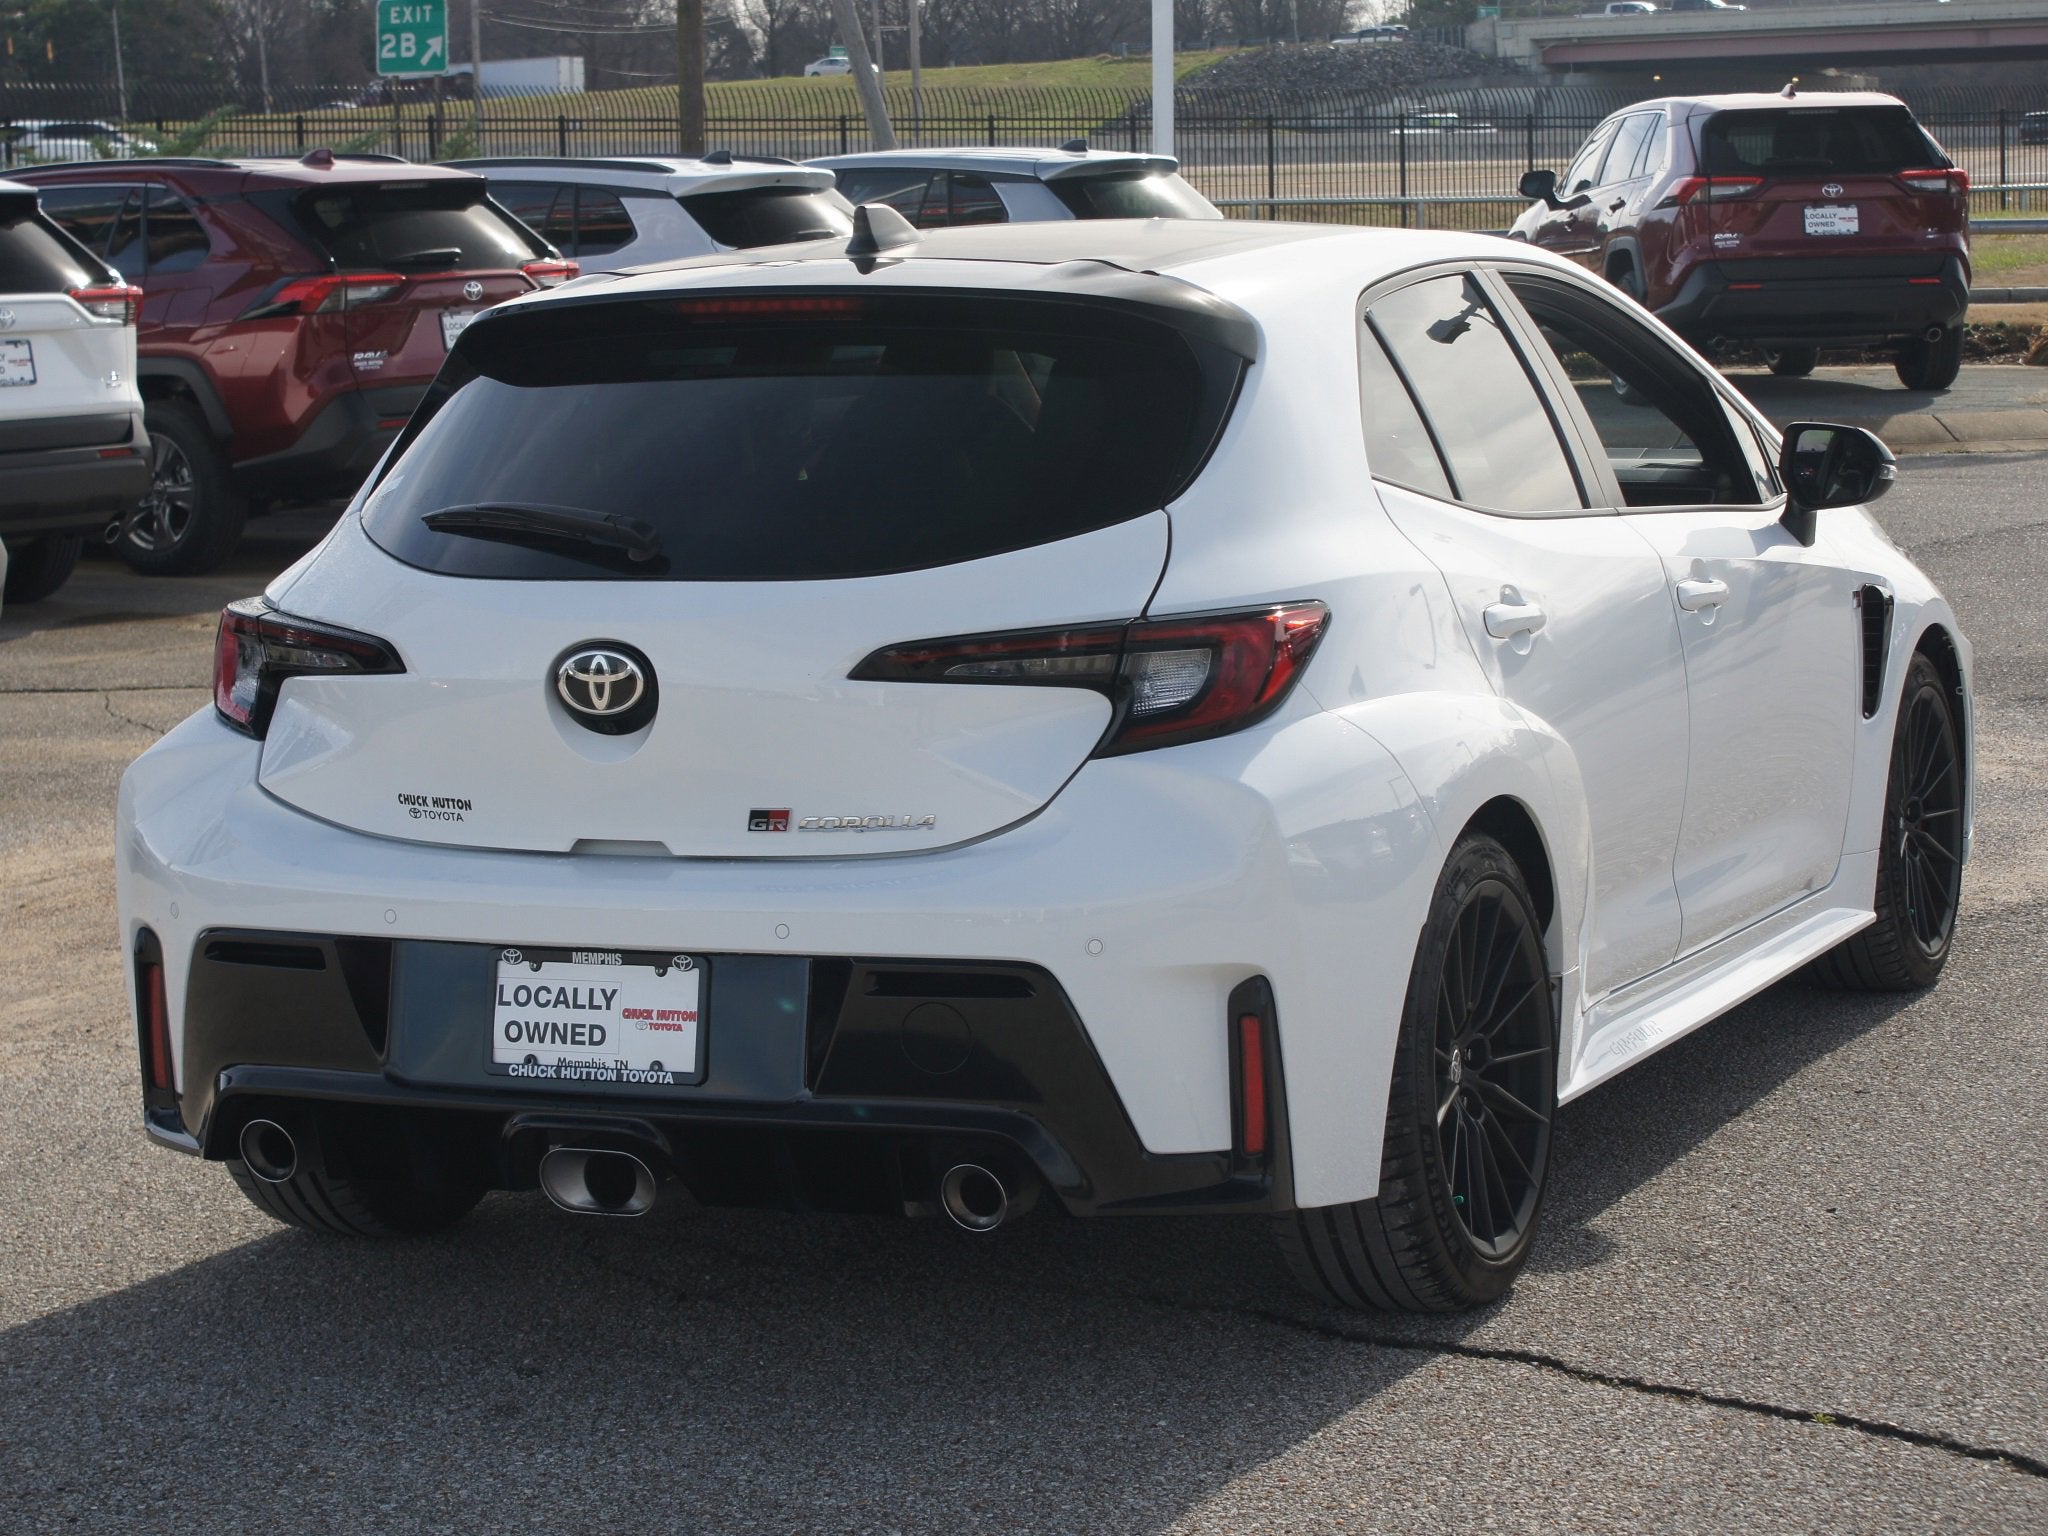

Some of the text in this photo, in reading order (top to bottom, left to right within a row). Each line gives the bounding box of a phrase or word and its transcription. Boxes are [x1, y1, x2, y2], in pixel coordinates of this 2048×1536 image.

[390, 5, 432, 24] EXIT
[381, 32, 416, 58] 2B
[1805, 212, 1838, 220] LOCALLY
[398, 793, 472, 811] CHUCK HUTTON
[422, 809, 464, 822] TOYOTA
[572, 951, 623, 966] MEMPHIS
[497, 984, 618, 1011] LOCALLY
[622, 1007, 697, 1022] CHUCK HUTTON
[504, 1020, 607, 1047] OWNED
[648, 1022, 683, 1032] TOYOTA
[613, 1059, 629, 1070] TN
[508, 1063, 674, 1085] CHUCK HUTTON TOYOTA
